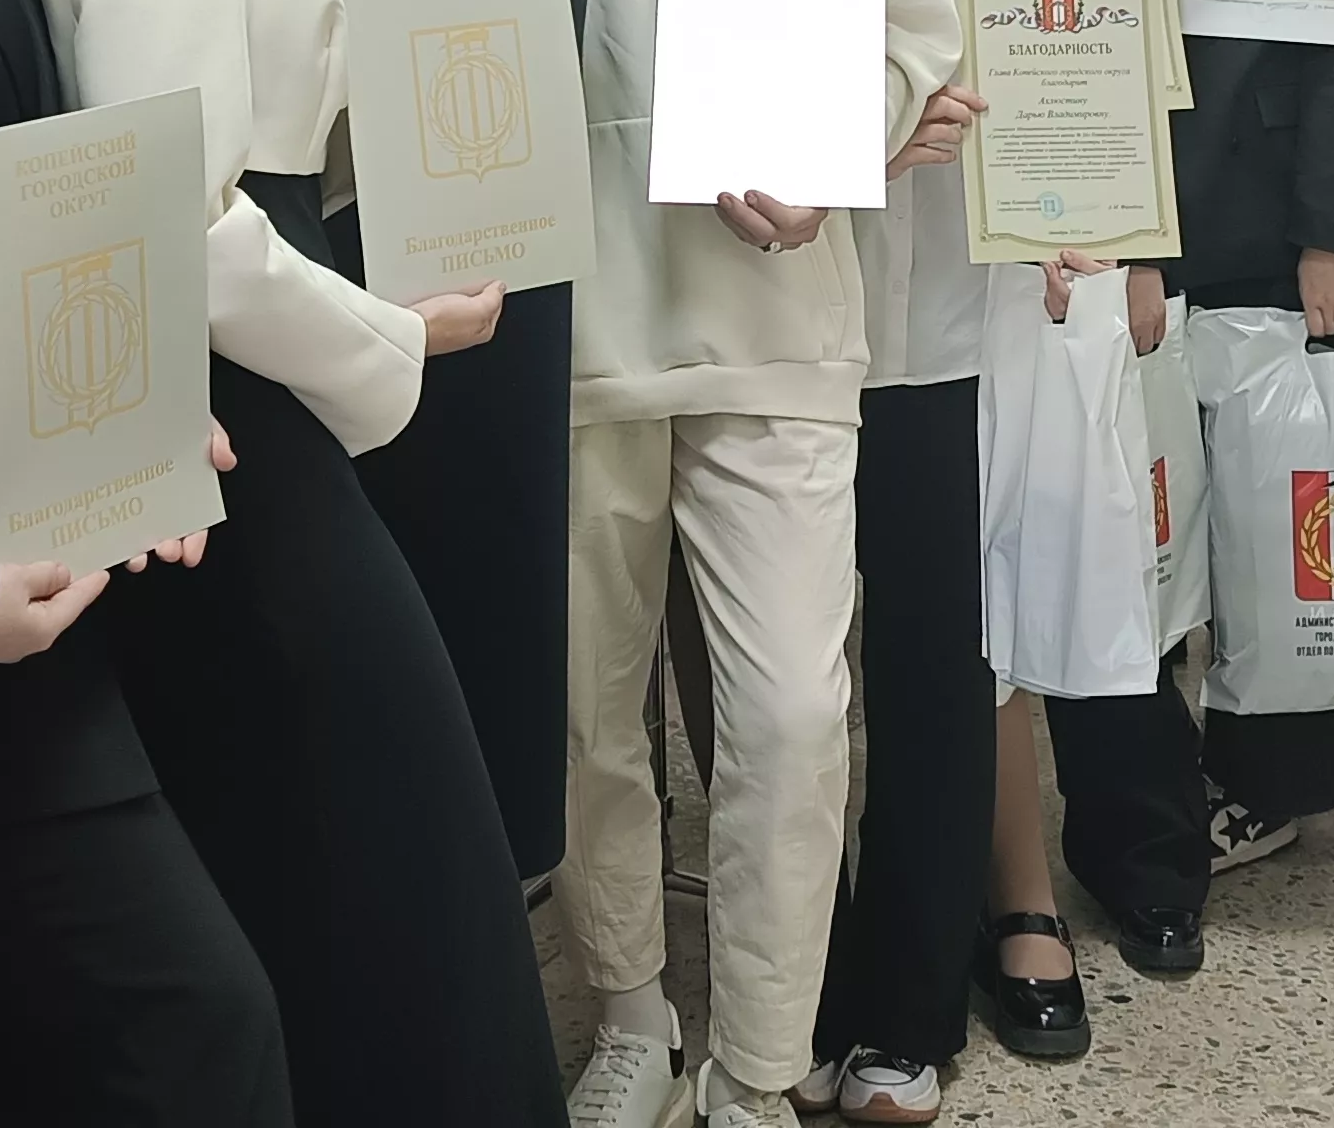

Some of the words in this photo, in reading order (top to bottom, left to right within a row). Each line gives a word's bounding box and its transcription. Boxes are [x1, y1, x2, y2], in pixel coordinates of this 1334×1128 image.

[1009, 43, 1113, 56] БЛАГОДАРНОСТЬ
[15, 129, 139, 179] КОПЕЙСКИЙ
[20, 156, 136, 203] ГОРОДСКОЙ
[49, 188, 113, 220] ОКРУГ
[405, 213, 557, 256] Благодарственное
[440, 242, 526, 274] ПИСЬМО
[8, 456, 176, 535] Благодарственное
[50, 497, 145, 549] ПИСЬМО
[1296, 646, 1322, 657] ОТДЕЛ
[1324, 646, 1334, 656] ПО
